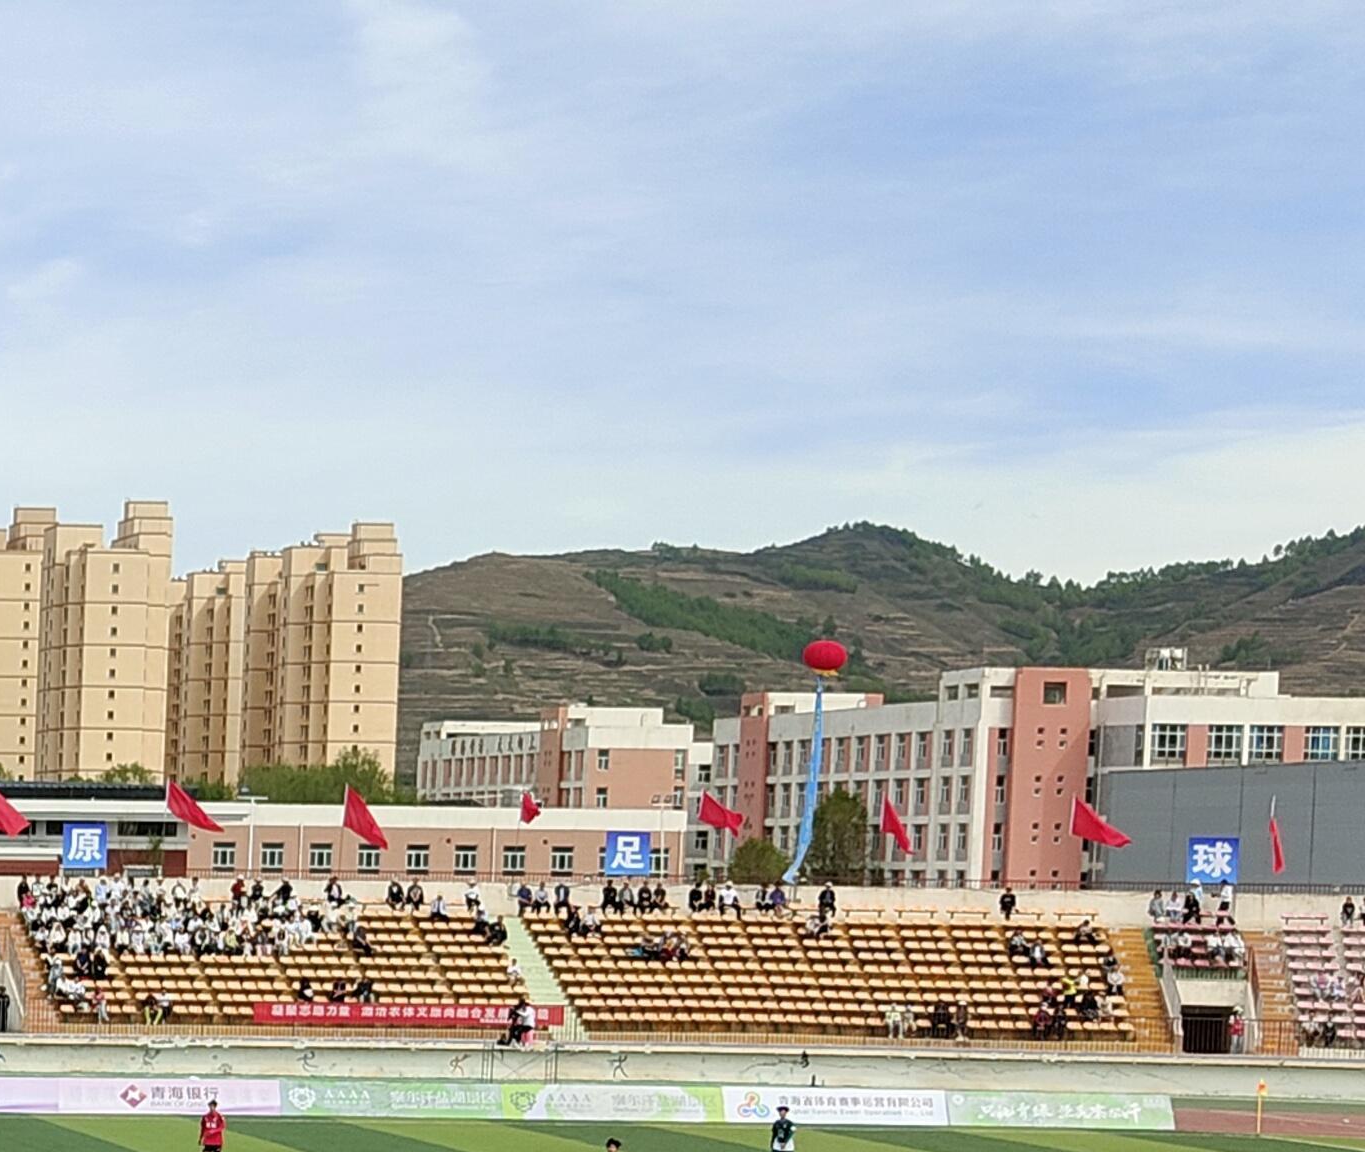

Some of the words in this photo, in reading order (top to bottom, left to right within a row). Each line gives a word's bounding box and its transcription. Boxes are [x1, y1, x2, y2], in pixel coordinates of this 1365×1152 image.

[66, 827, 103, 863] 原
[610, 835, 645, 870] 足
[1192, 841, 1233, 878] 球
[151, 1085, 220, 1101] 青海银行
